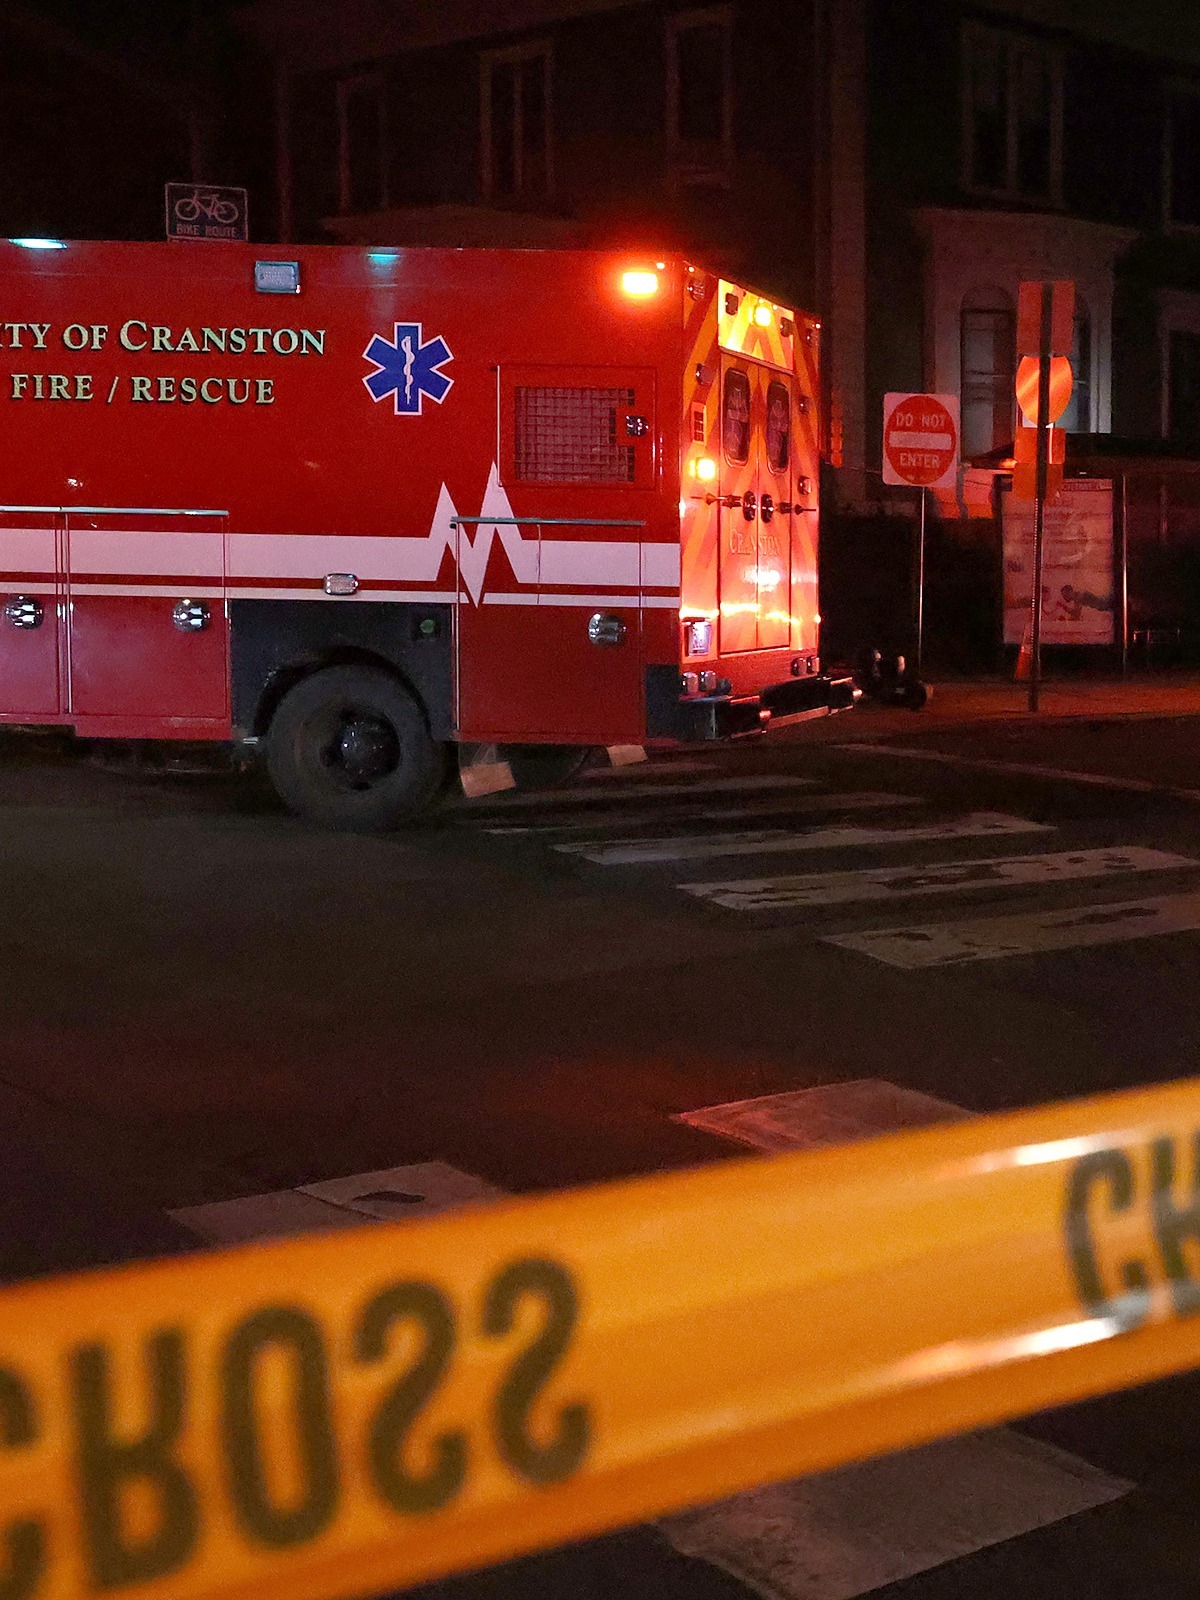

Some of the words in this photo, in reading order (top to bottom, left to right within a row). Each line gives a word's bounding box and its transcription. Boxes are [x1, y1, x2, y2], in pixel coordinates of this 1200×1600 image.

[176, 224, 200, 236] BIKE
[205, 225, 237, 238] ROUTE
[0, 322, 51, 348] TY
[63, 323, 108, 350] OF
[120, 320, 325, 355] CRANSTON
[11, 373, 94, 400] FIRE
[131, 376, 275, 404] RESCUE
[896, 412, 914, 427] DO
[921, 413, 946, 428] NOT
[900, 452, 941, 469] ENTER
